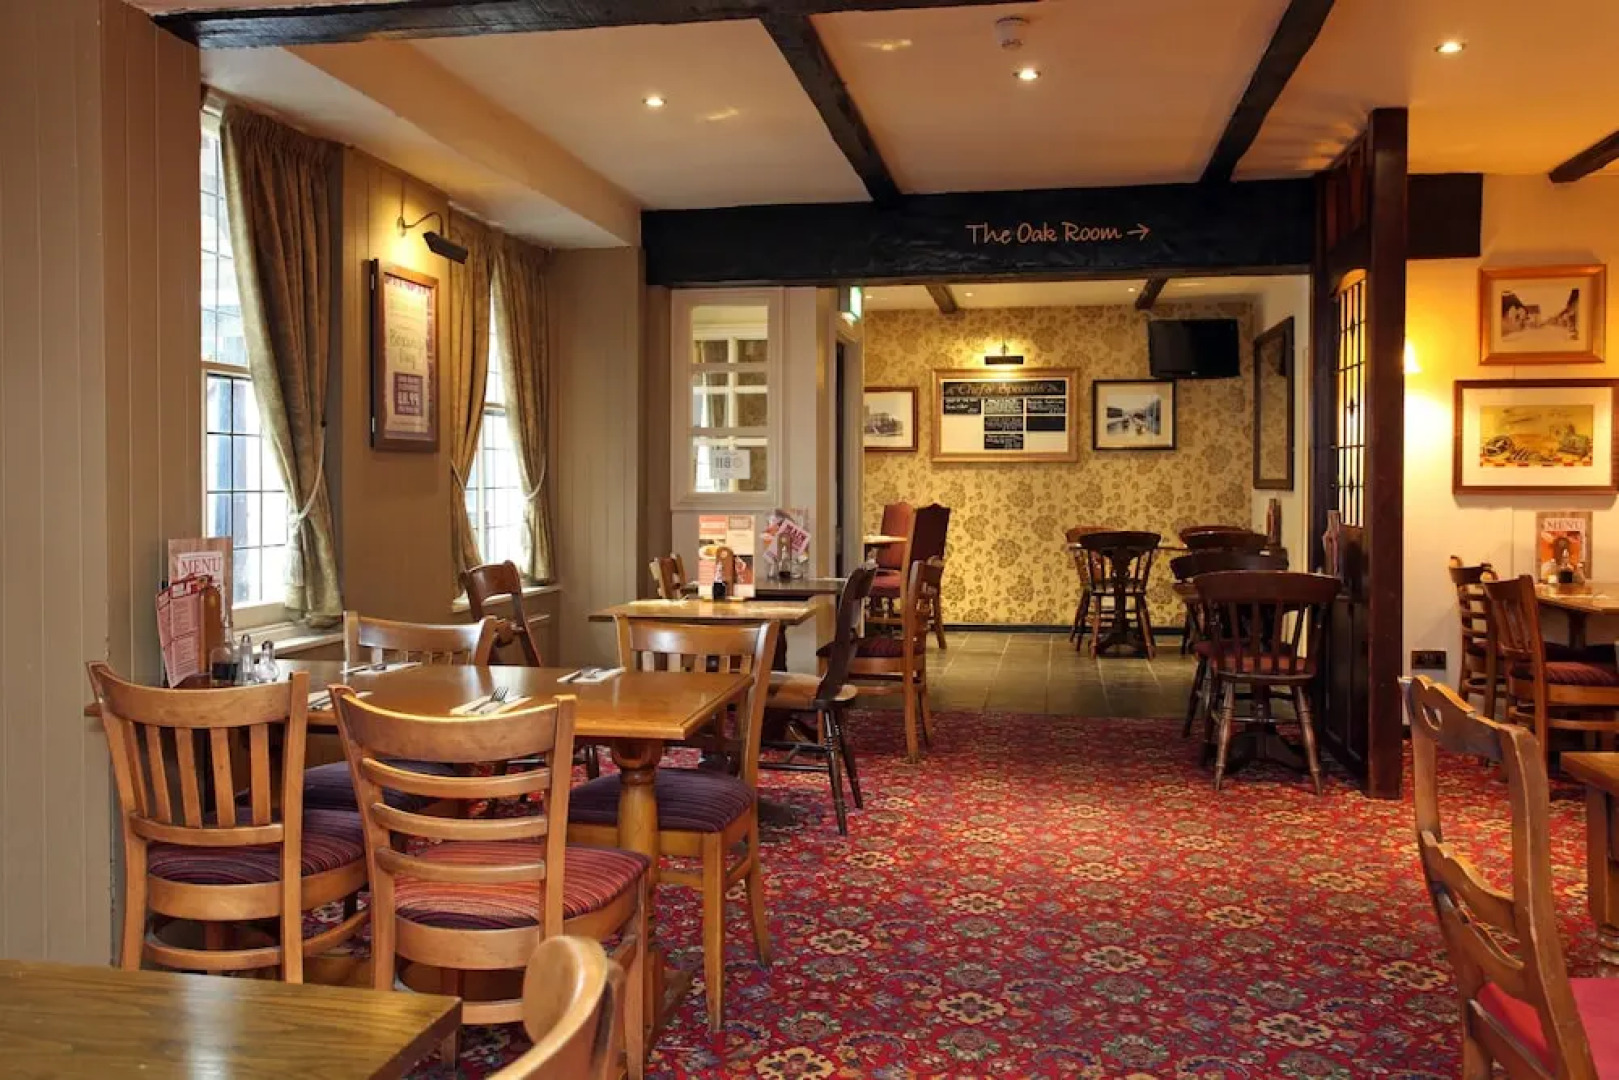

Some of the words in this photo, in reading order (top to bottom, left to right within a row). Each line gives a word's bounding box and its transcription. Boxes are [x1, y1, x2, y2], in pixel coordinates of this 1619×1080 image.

[964, 221, 1012, 245] The
[1016, 222, 1058, 244] Oak
[1061, 221, 1123, 243] Room
[1546, 519, 1583, 530] MENU
[181, 557, 221, 574] MENU
